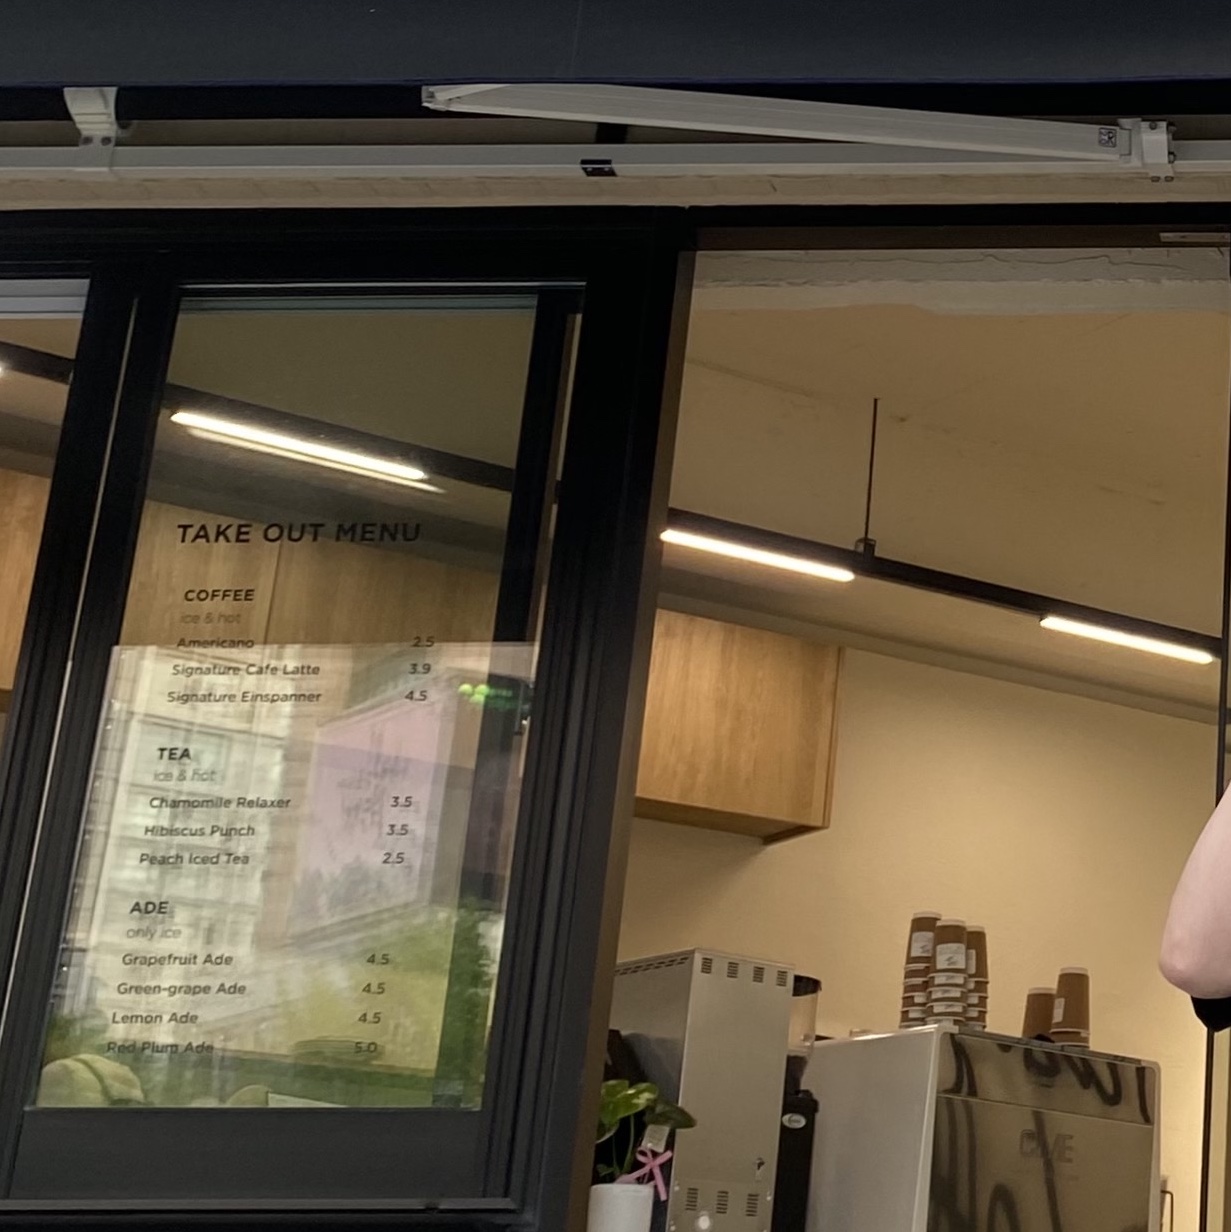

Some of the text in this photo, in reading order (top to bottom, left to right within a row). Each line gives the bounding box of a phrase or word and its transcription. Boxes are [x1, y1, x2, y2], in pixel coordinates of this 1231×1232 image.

[177, 523, 422, 543] TAKE OUT MENU
[184, 588, 256, 602] COFFEE
[180, 612, 200, 624] ice
[217, 612, 241, 624] hot
[177, 637, 255, 649] Americano
[411, 636, 435, 648] 2.5
[171, 663, 320, 678] Signature Cafe Latte
[407, 663, 431, 675] 3.9
[167, 691, 322, 705] Signature Einspanner
[404, 690, 427, 702] 4.5
[157, 748, 192, 760] TEA
[153, 770, 173, 782] ice
[191, 769, 216, 782] hot
[149, 797, 291, 809] Chamomile Relaxer
[390, 796, 413, 808] 3.5
[144, 825, 255, 837] Hibiscus Punch
[386, 824, 409, 836] 3.5
[139, 853, 250, 865] Peach Iced Tea
[382, 853, 405, 865] 2.5
[129, 901, 170, 914] ADE
[126, 927, 182, 940] only ice
[121, 954, 234, 968] Grapefruit Ade
[366, 954, 390, 965] 4.5
[116, 983, 247, 997] Green-grape Ade
[362, 983, 386, 995] 4.5
[111, 1012, 199, 1024] Lemon Ade
[357, 1012, 381, 1024] 4.5
[106, 1041, 214, 1053] Red Plum Ade
[354, 1042, 378, 1053] 5.0
